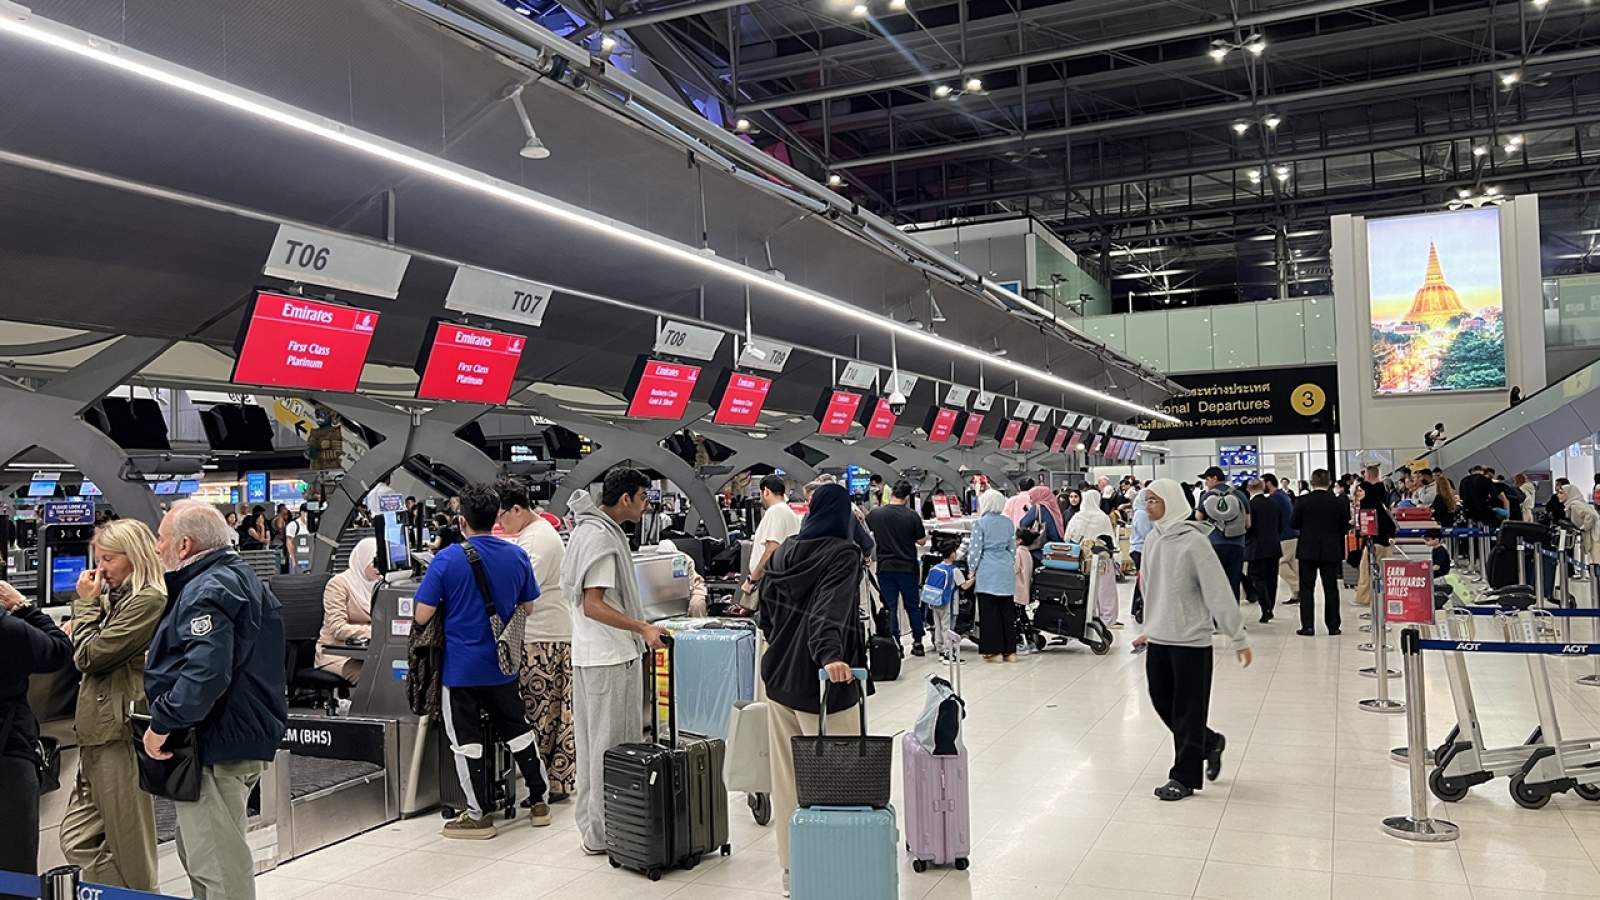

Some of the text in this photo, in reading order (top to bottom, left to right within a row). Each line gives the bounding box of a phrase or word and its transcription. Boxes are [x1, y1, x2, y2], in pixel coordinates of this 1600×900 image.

[285, 240, 330, 271] T06
[512, 290, 543, 314] T07
[282, 302, 333, 323] Emirates
[455, 331, 492, 347] Emirates
[664, 330, 686, 347] T08
[288, 340, 330, 356] First Class
[286, 355, 323, 369] Platinum
[770, 349, 786, 365] T09
[458, 362, 489, 374] First Class
[456, 374, 484, 385] Platinum
[1198, 397, 1271, 414] Departures
[1301, 391, 1315, 408] 3
[1200, 417, 1239, 427] Passport
[1240, 414, 1273, 425] Control
[1387, 566, 1406, 577] EARN
[1387, 577, 1426, 588] SKYWARDS
[1387, 587, 1409, 597] MILES
[1456, 642, 1481, 651] AOT
[1562, 644, 1589, 653] AOT
[300, 728, 332, 746] (BHS)
